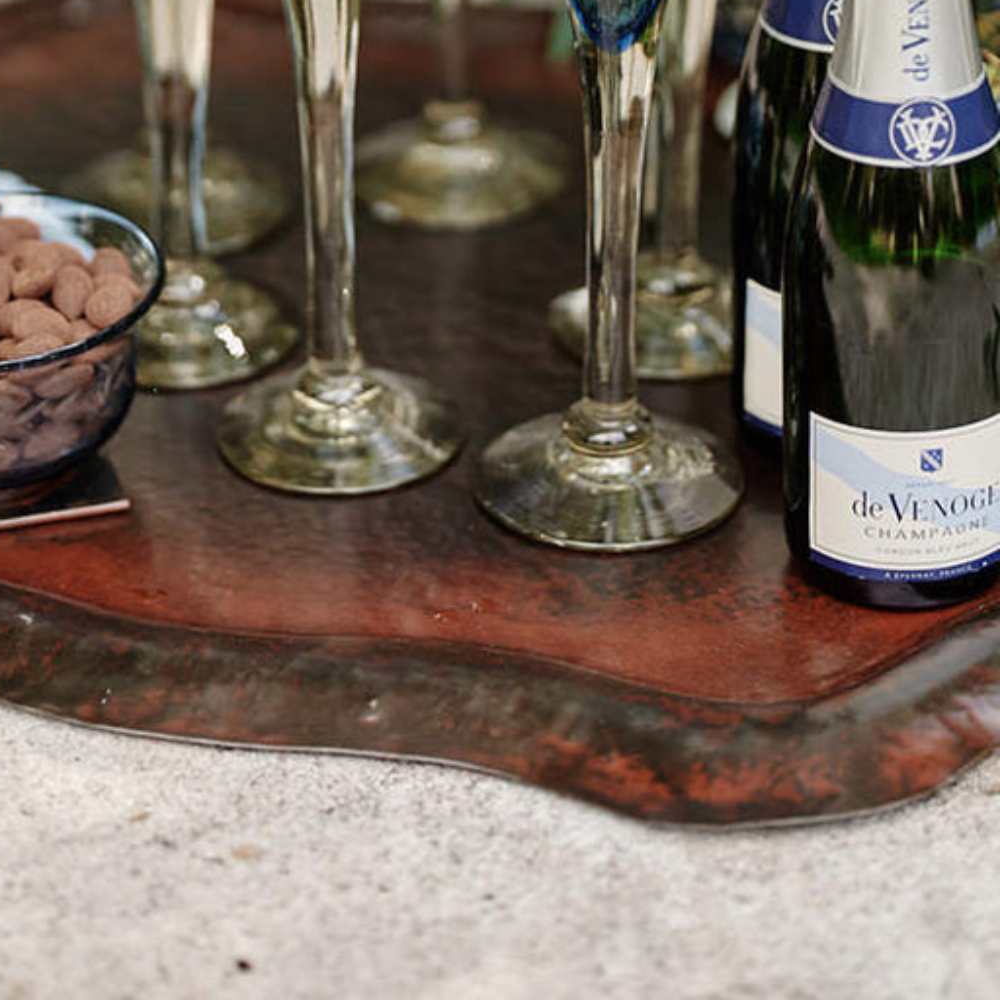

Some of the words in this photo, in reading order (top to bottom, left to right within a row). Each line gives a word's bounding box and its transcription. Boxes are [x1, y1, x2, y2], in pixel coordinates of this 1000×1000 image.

[902, 53, 931, 82] de
[851, 490, 884, 520] de
[863, 515, 989, 541] CHAMPAGNE
